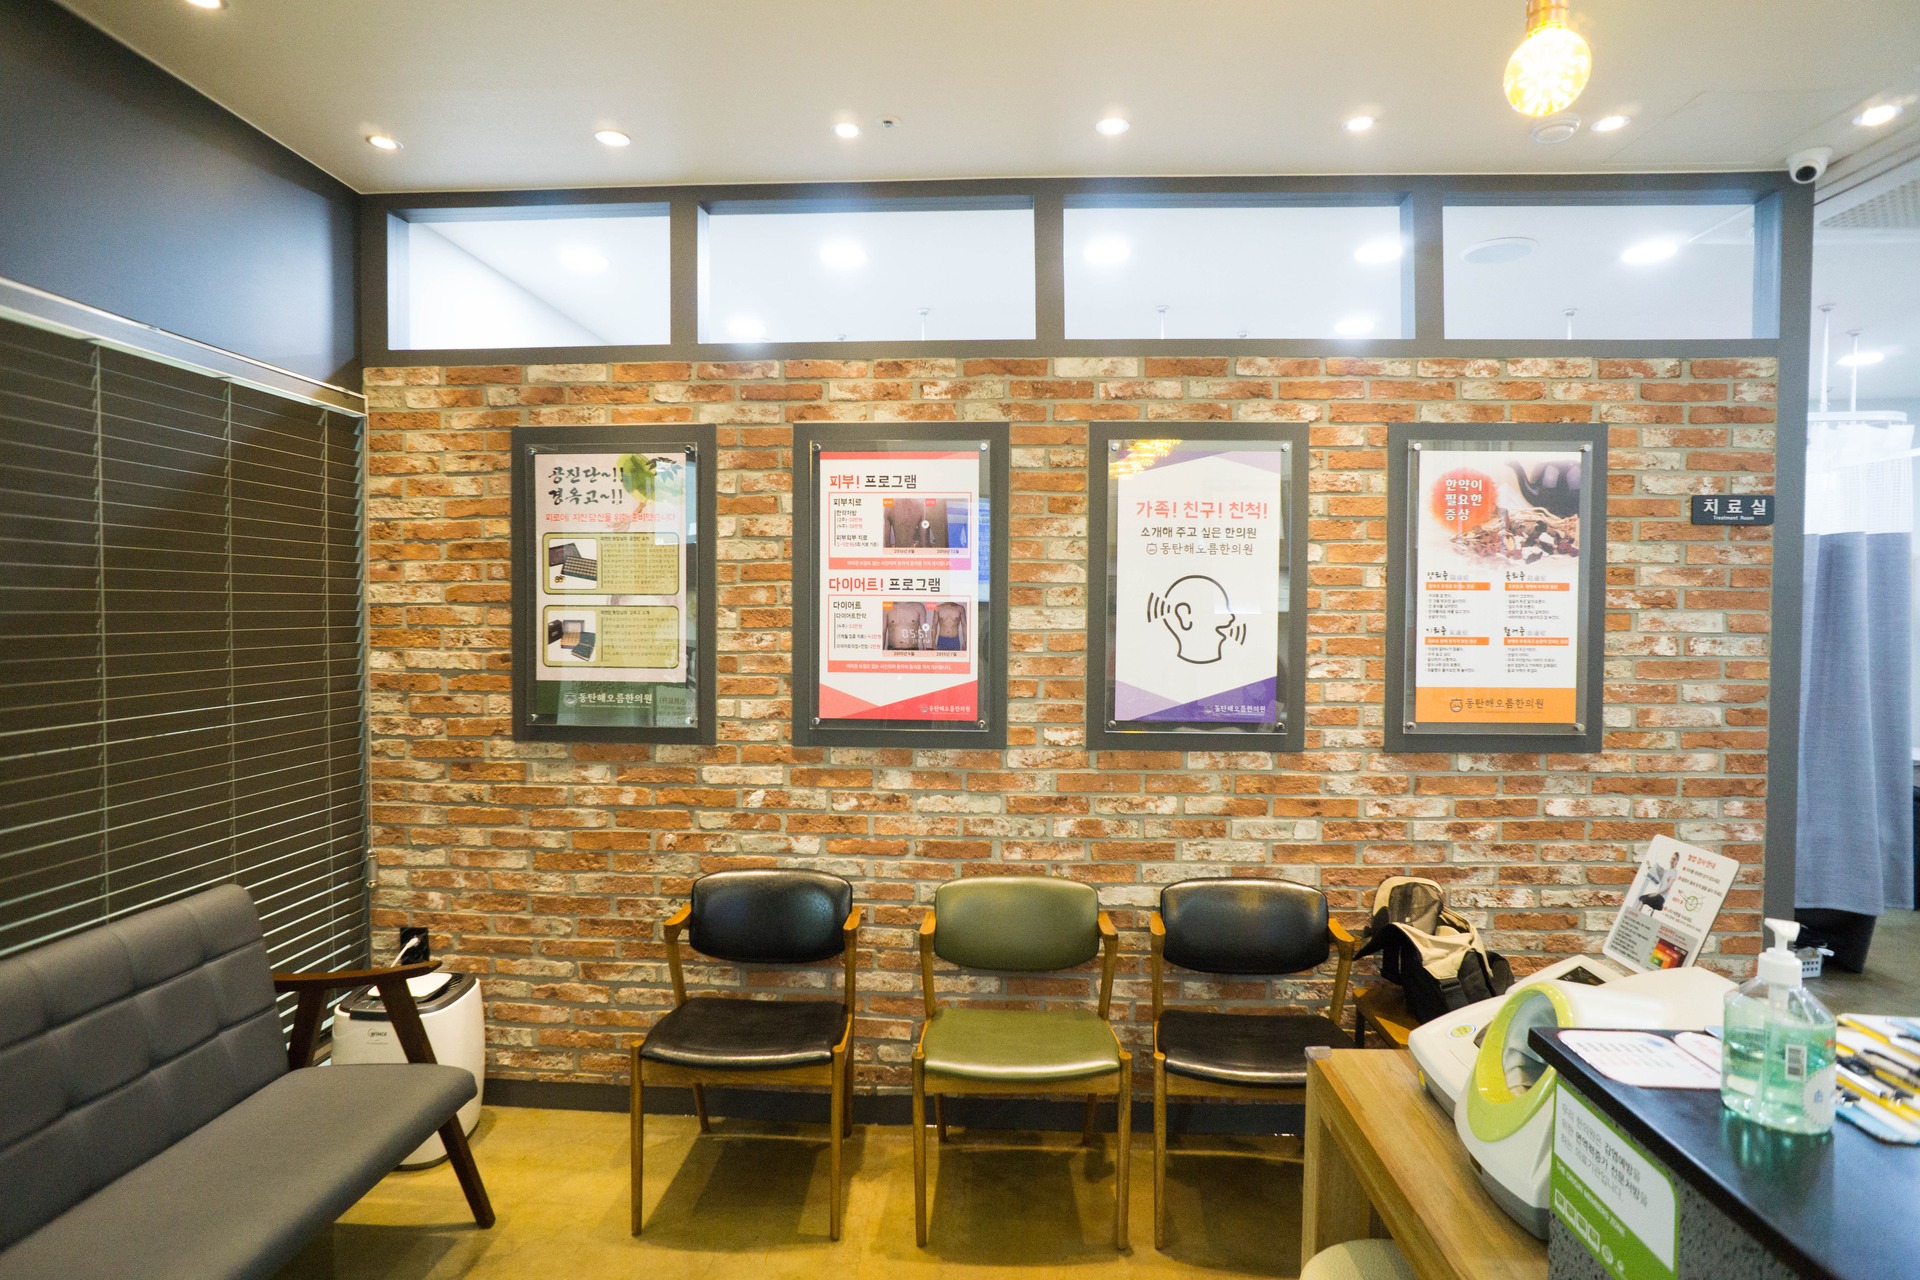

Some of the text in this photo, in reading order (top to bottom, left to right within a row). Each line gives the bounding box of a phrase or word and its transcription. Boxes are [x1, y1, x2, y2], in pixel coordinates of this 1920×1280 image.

[830, 474, 917, 489] 피부! 프로그램
[1445, 478, 1483, 492] 한약이
[834, 498, 862, 507] 피부치료
[1444, 494, 1483, 506] 필요한
[1136, 500, 1268, 520] 가족! 친구! 친척!
[1444, 508, 1470, 521] 증상
[1140, 527, 1257, 539] 소개해 주고 싶은 한의원
[1160, 543, 1253, 555] 동탄해오름한의원
[829, 578, 940, 592] 다이어트! 프로그램
[833, 601, 862, 610] 다이어트
[578, 693, 652, 704] 동탄해오름한의원
[1466, 698, 1544, 709] 동탄해오름한의원
